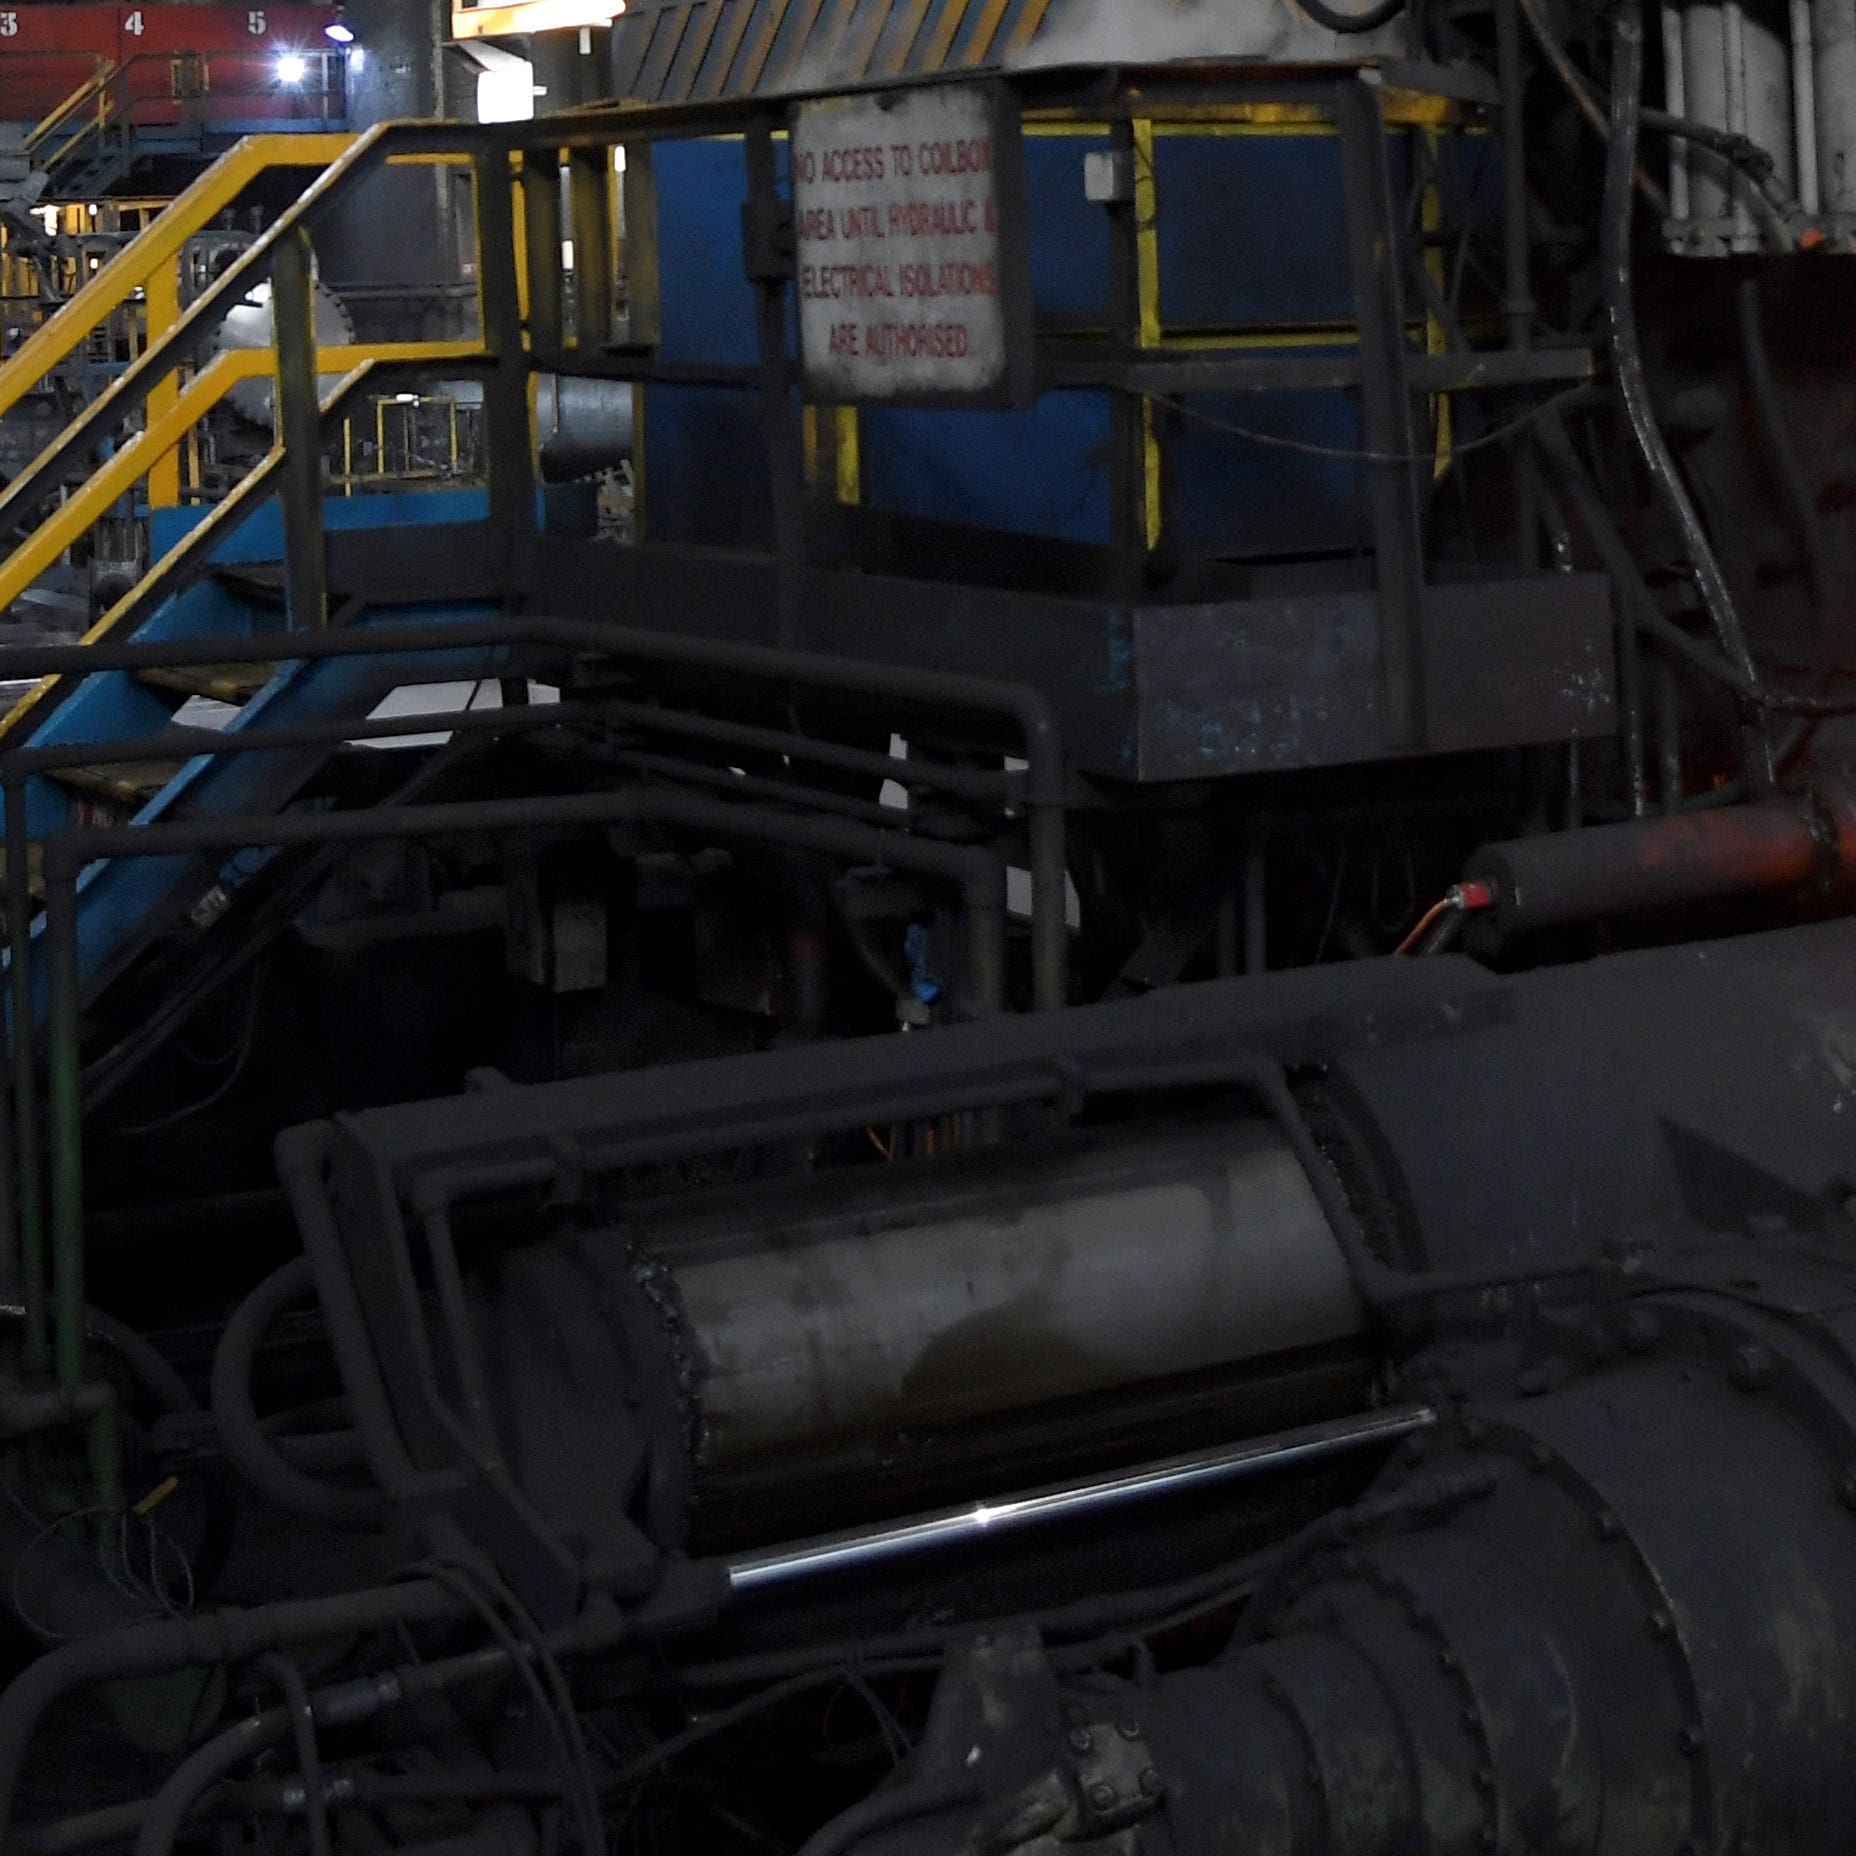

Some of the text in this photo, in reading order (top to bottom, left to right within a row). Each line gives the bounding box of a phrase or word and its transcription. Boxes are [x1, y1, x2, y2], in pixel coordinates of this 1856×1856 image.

[0, 10, 19, 37] 3
[124, 10, 145, 36] 4
[247, 9, 267, 35] 5
[823, 146, 883, 181] ACCESS
[891, 144, 912, 176] TO
[799, 208, 834, 239] AREA
[841, 206, 885, 238] UNTIL
[888, 201, 976, 236] HYDRAULIC
[802, 265, 893, 298] ELECTRICAL
[830, 323, 858, 355] ARE
